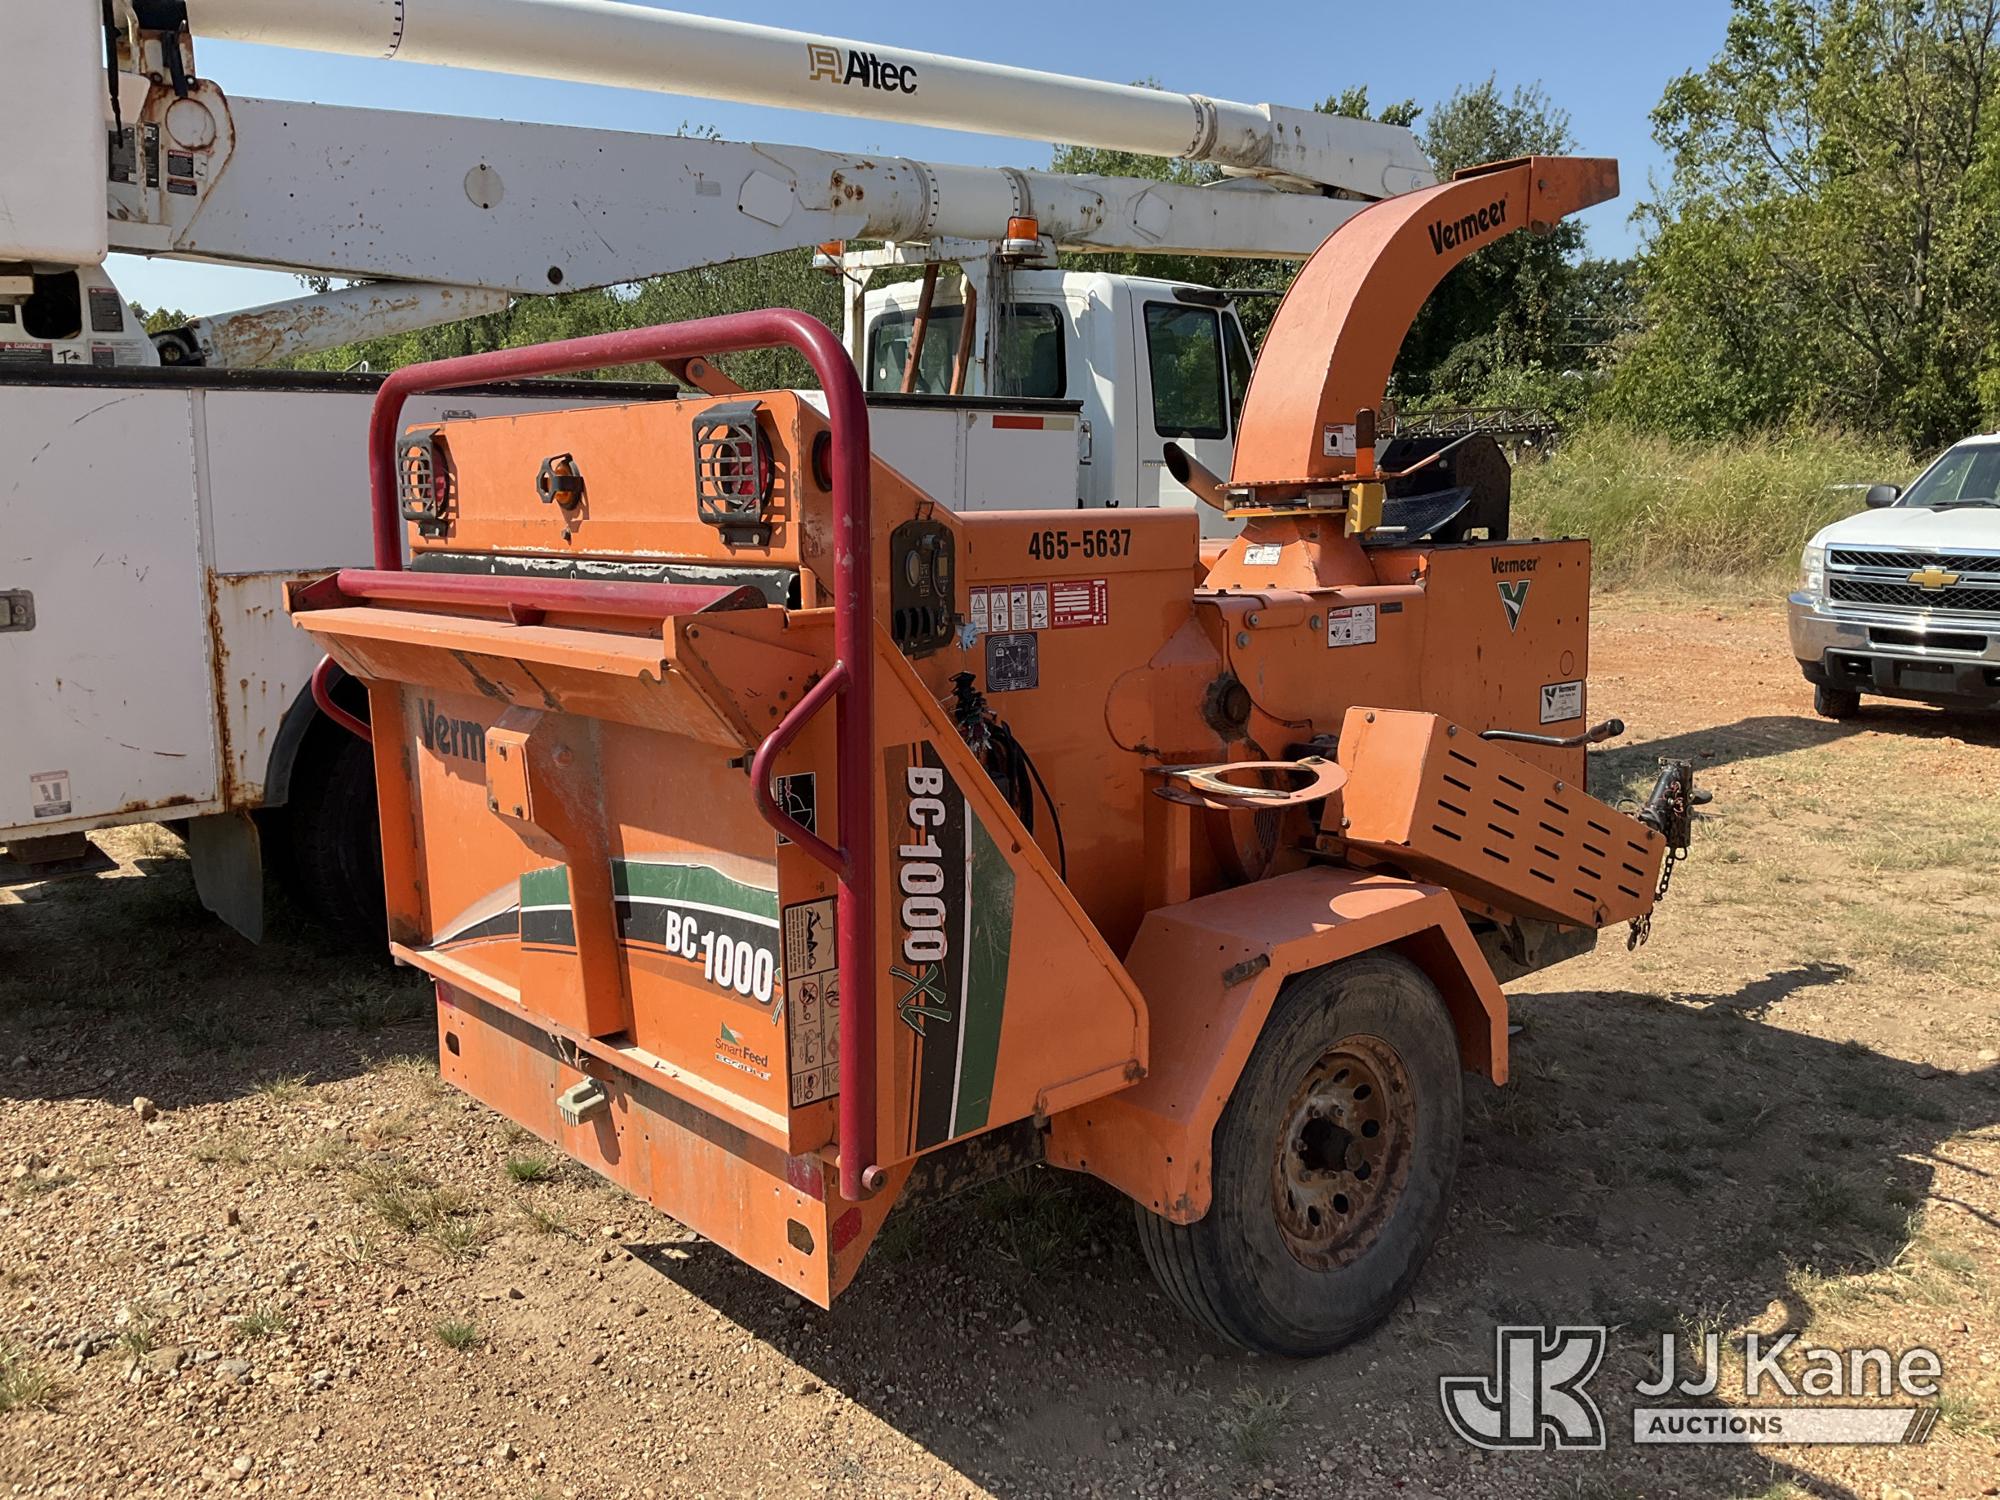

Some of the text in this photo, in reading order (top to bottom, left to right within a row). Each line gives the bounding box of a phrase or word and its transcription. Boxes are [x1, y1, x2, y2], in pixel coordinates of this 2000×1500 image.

[843, 49, 917, 95] Altec
[1428, 199, 1506, 256] Vermeer
[1028, 529, 1131, 560] 465-5637
[1491, 556, 1538, 574] Vermeer
[418, 697, 486, 764] Verm
